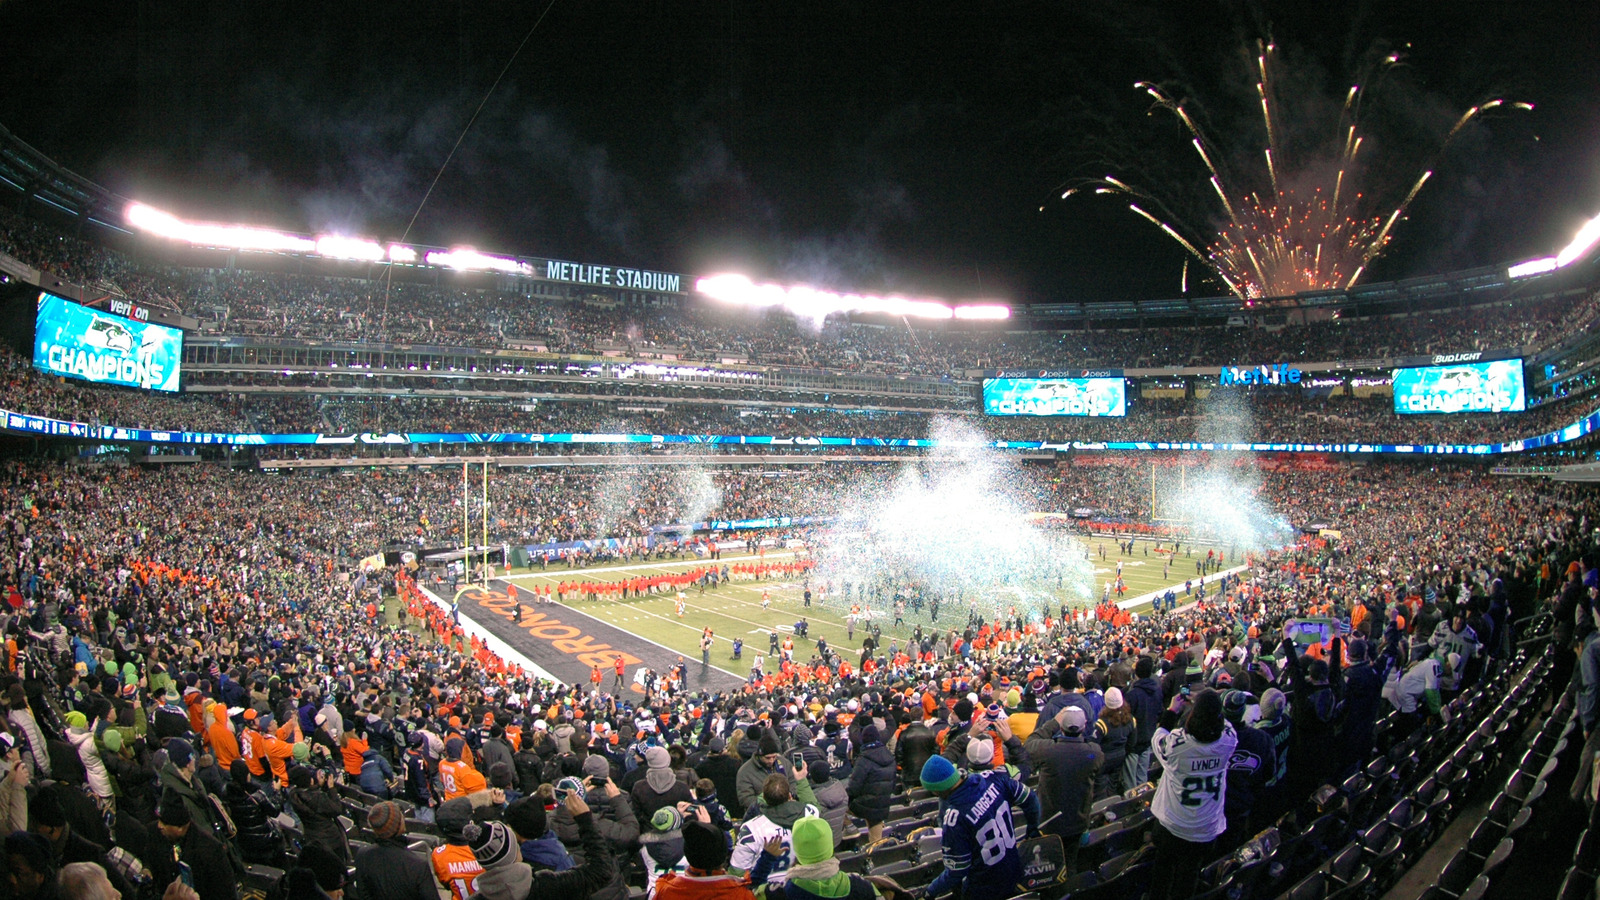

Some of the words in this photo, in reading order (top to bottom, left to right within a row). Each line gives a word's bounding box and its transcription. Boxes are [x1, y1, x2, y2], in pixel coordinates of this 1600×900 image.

[547, 261, 611, 285] METLIFE
[616, 269, 680, 292] STADIUM
[110, 299, 149, 323] verizon
[49, 344, 164, 387] CHAMPIONS
[1434, 354, 1455, 364] BUD
[1455, 352, 1482, 362] LIGHT
[1005, 370, 1027, 378] pepsi
[1047, 370, 1070, 378] pepsi
[1089, 370, 1111, 378] pepsi
[1220, 363, 1301, 385] MetLife
[998, 400, 1110, 415] CHAMPIONS
[1408, 391, 1512, 412] CHAMPIONS
[464, 591, 644, 669] BRONCOS
[1191, 758, 1220, 772] LYNCH
[441, 772, 457, 793] 18
[1181, 771, 1223, 806] 24
[965, 782, 1000, 825] LARGENT
[975, 800, 1017, 866] 80
[1024, 863, 1056, 877] XLVIII
